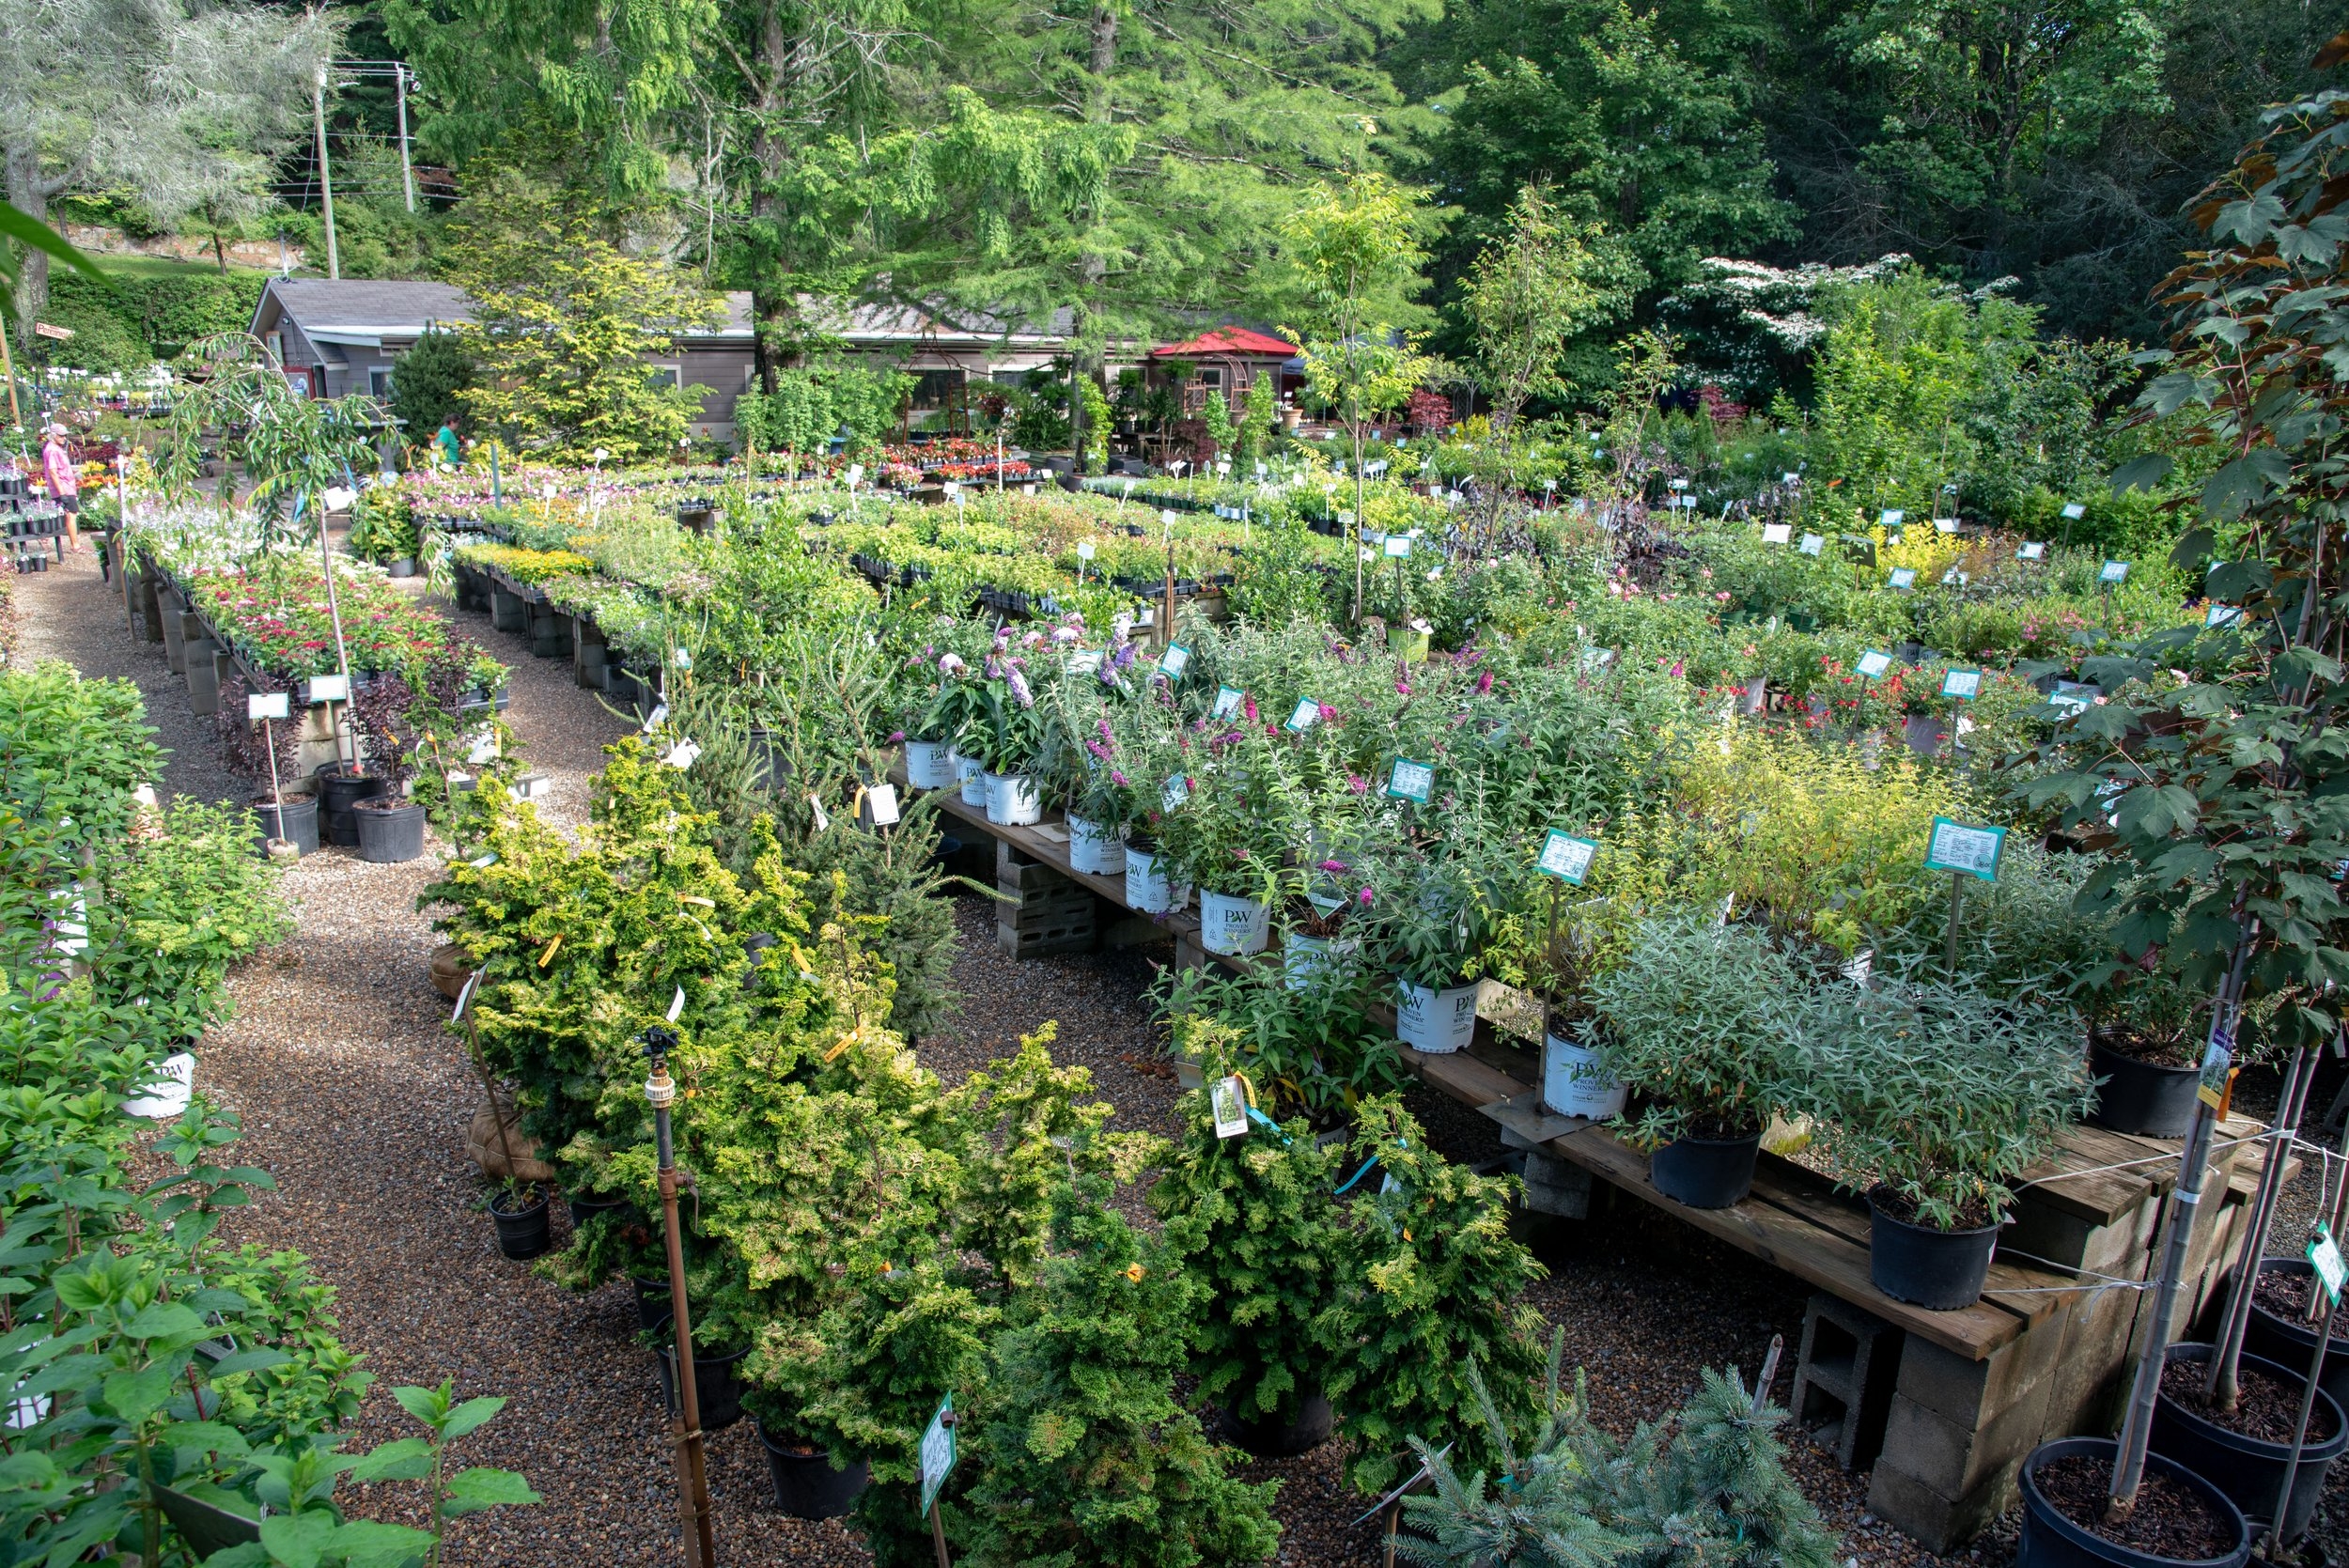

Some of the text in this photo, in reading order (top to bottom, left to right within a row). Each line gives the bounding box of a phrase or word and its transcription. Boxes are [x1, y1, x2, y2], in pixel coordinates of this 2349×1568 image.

[930, 750, 949, 760] PW
[967, 767, 984, 778] PW
[1224, 909, 1252, 923] PW
[160, 1062, 185, 1077] PW
[1573, 1083, 1603, 1092] WINNER
